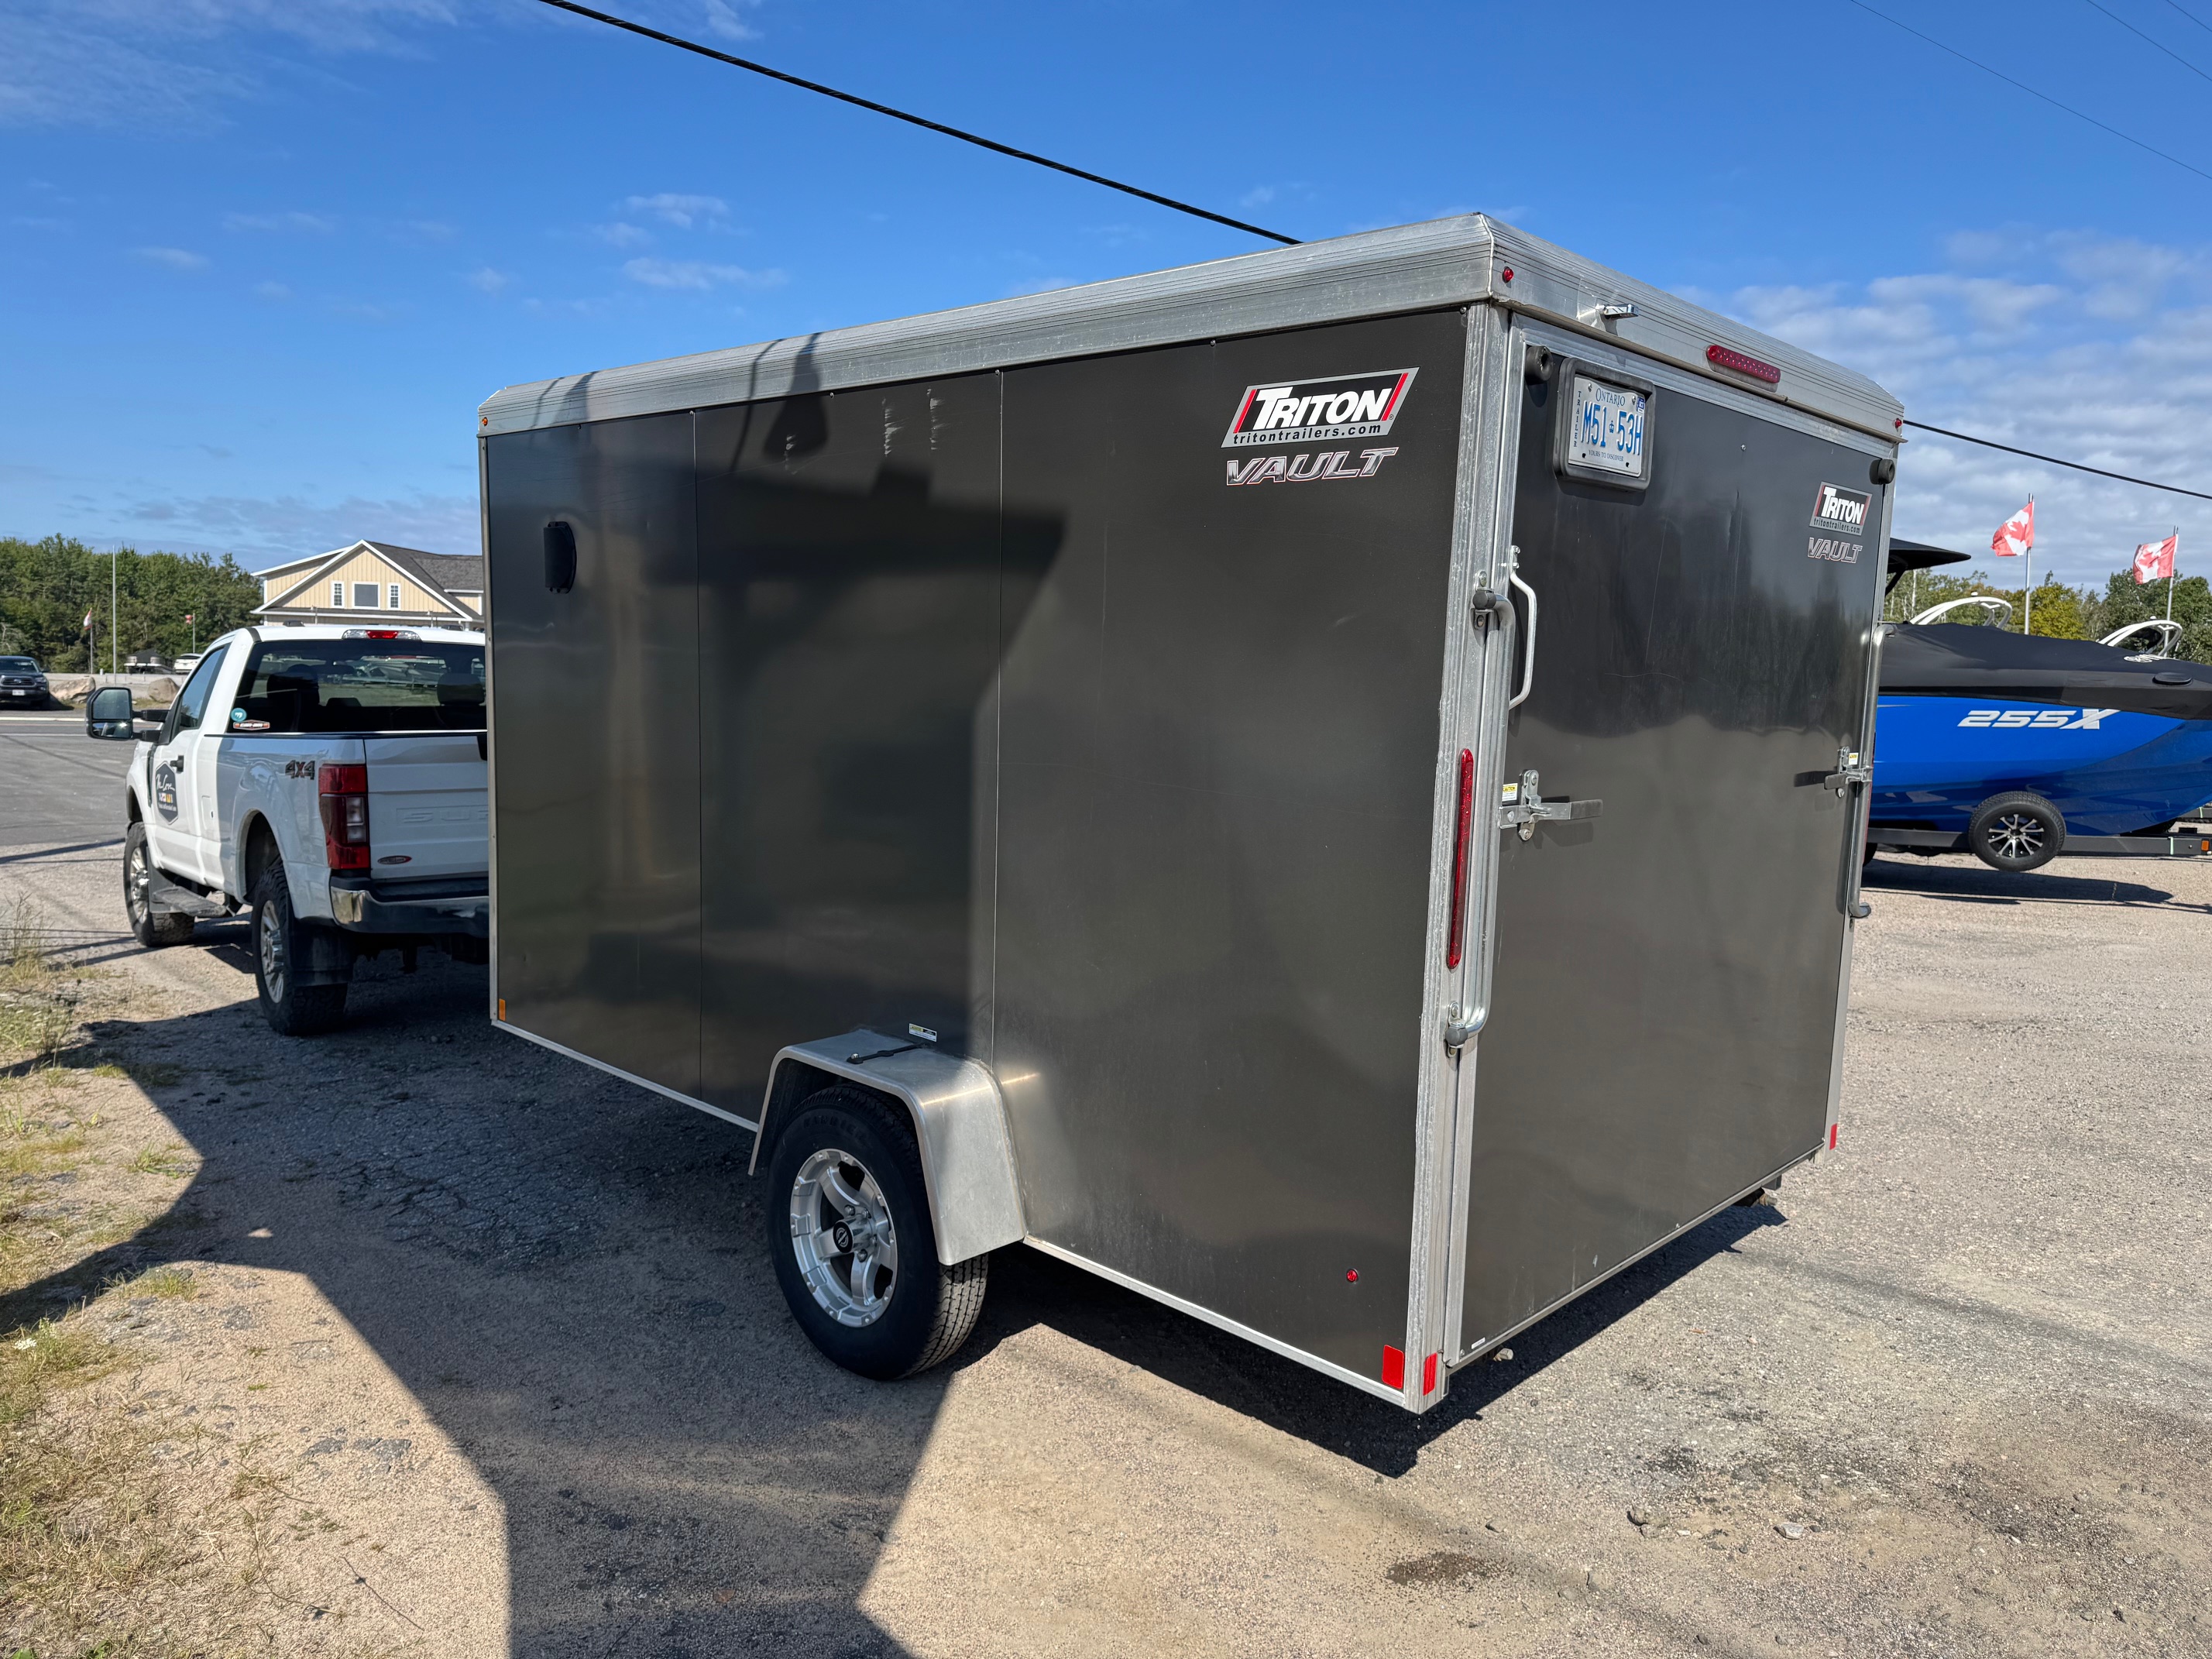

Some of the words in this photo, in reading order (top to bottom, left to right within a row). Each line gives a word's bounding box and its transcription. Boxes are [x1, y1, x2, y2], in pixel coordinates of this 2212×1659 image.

[1252, 386, 1393, 431] TRITON
[1595, 388, 1626, 407] ONTARIO
[1233, 424, 1381, 444] tritontrailers.com
[1226, 446, 1400, 486] VAULT
[1821, 486, 1864, 524] TRITON
[1813, 518, 1860, 534] tritontrailers.com
[1808, 538, 1863, 563] VAULT
[1957, 708, 2122, 730] 255X
